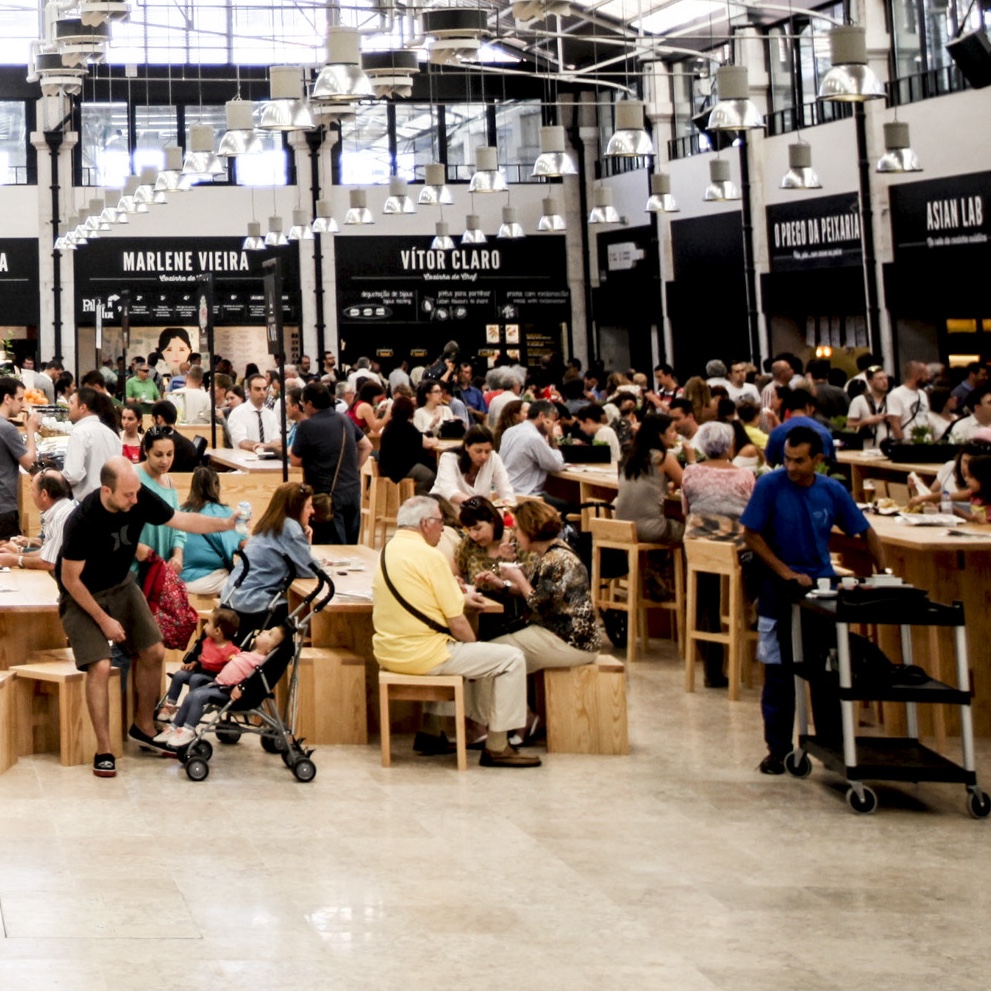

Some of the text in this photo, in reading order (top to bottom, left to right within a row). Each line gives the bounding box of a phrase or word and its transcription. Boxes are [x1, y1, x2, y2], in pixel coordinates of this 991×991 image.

[927, 196, 982, 231] ASIAN LAB
[774, 213, 860, 248] O PREGO DA PEIXARIA
[123, 251, 249, 271] MARLENE VIEIRA
[401, 247, 500, 269] VÍTOR CLARO
